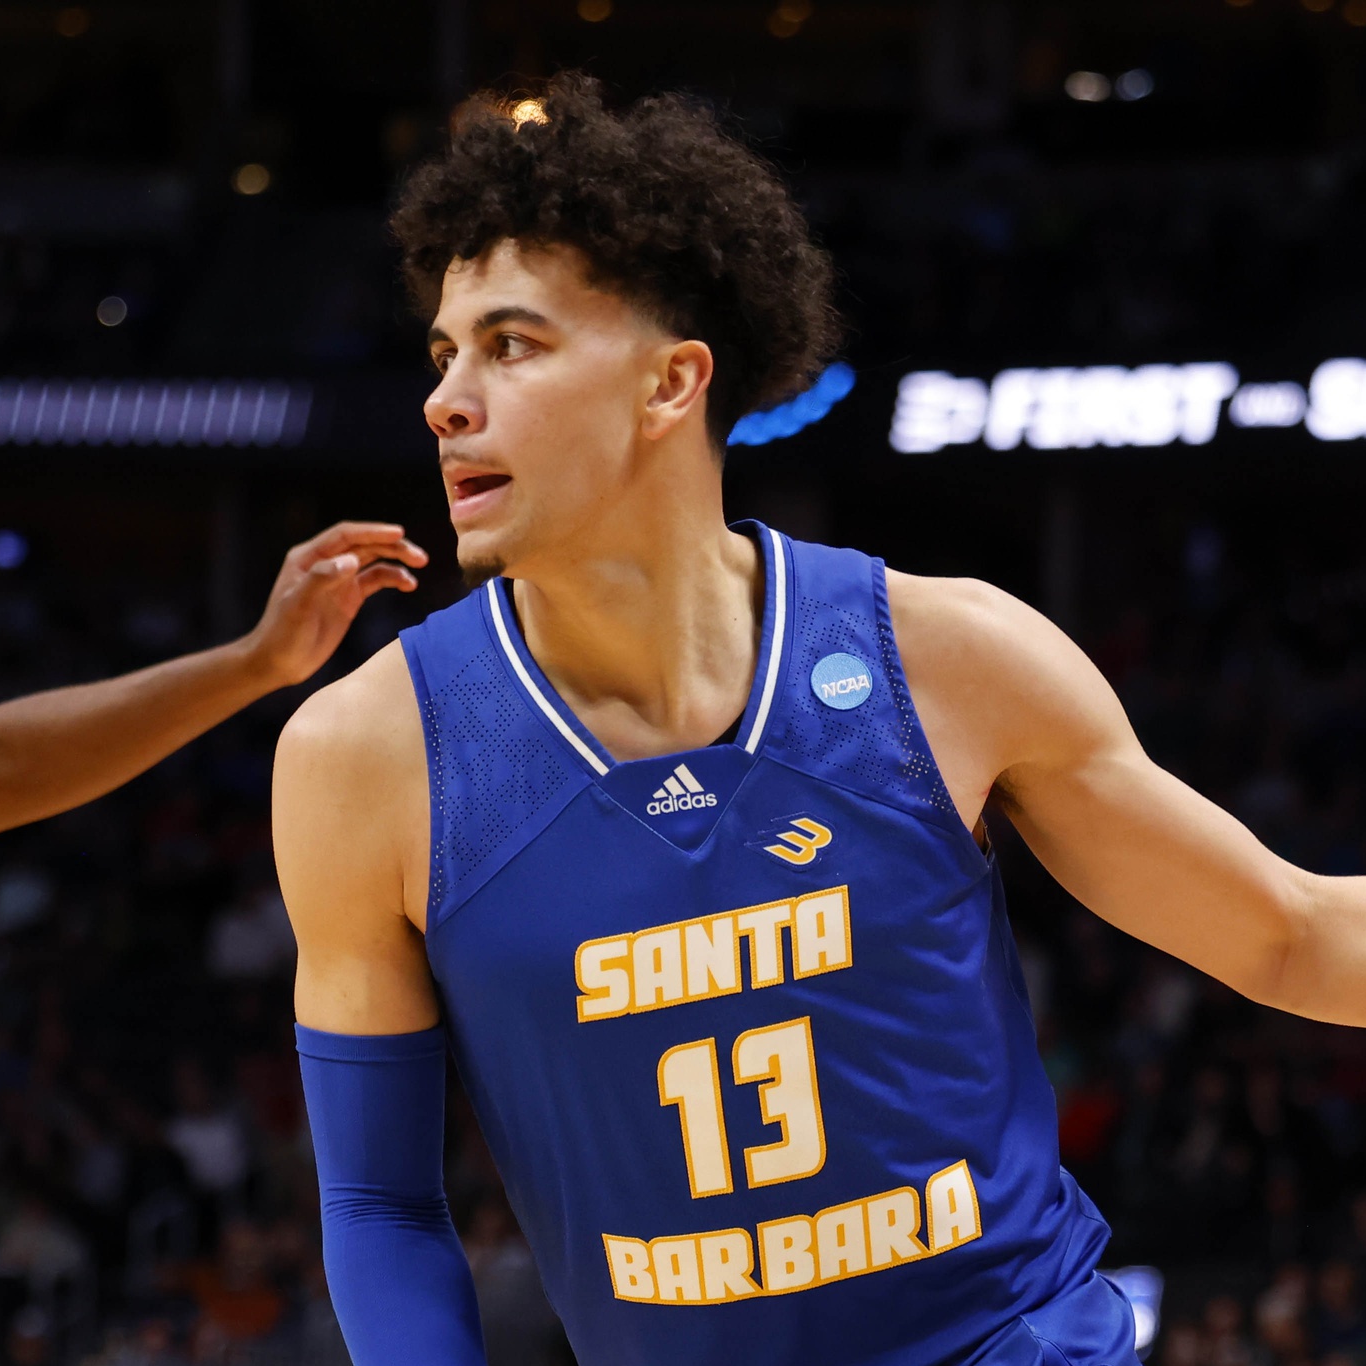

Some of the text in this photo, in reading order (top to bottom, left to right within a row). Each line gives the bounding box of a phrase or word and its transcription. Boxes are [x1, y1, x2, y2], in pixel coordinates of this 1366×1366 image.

[821, 674, 871, 699] NCAA
[646, 792, 718, 816] adidas
[574, 884, 853, 1024] SANTA
[656, 1015, 828, 1200] 13
[601, 1158, 983, 1307] BARBARA
